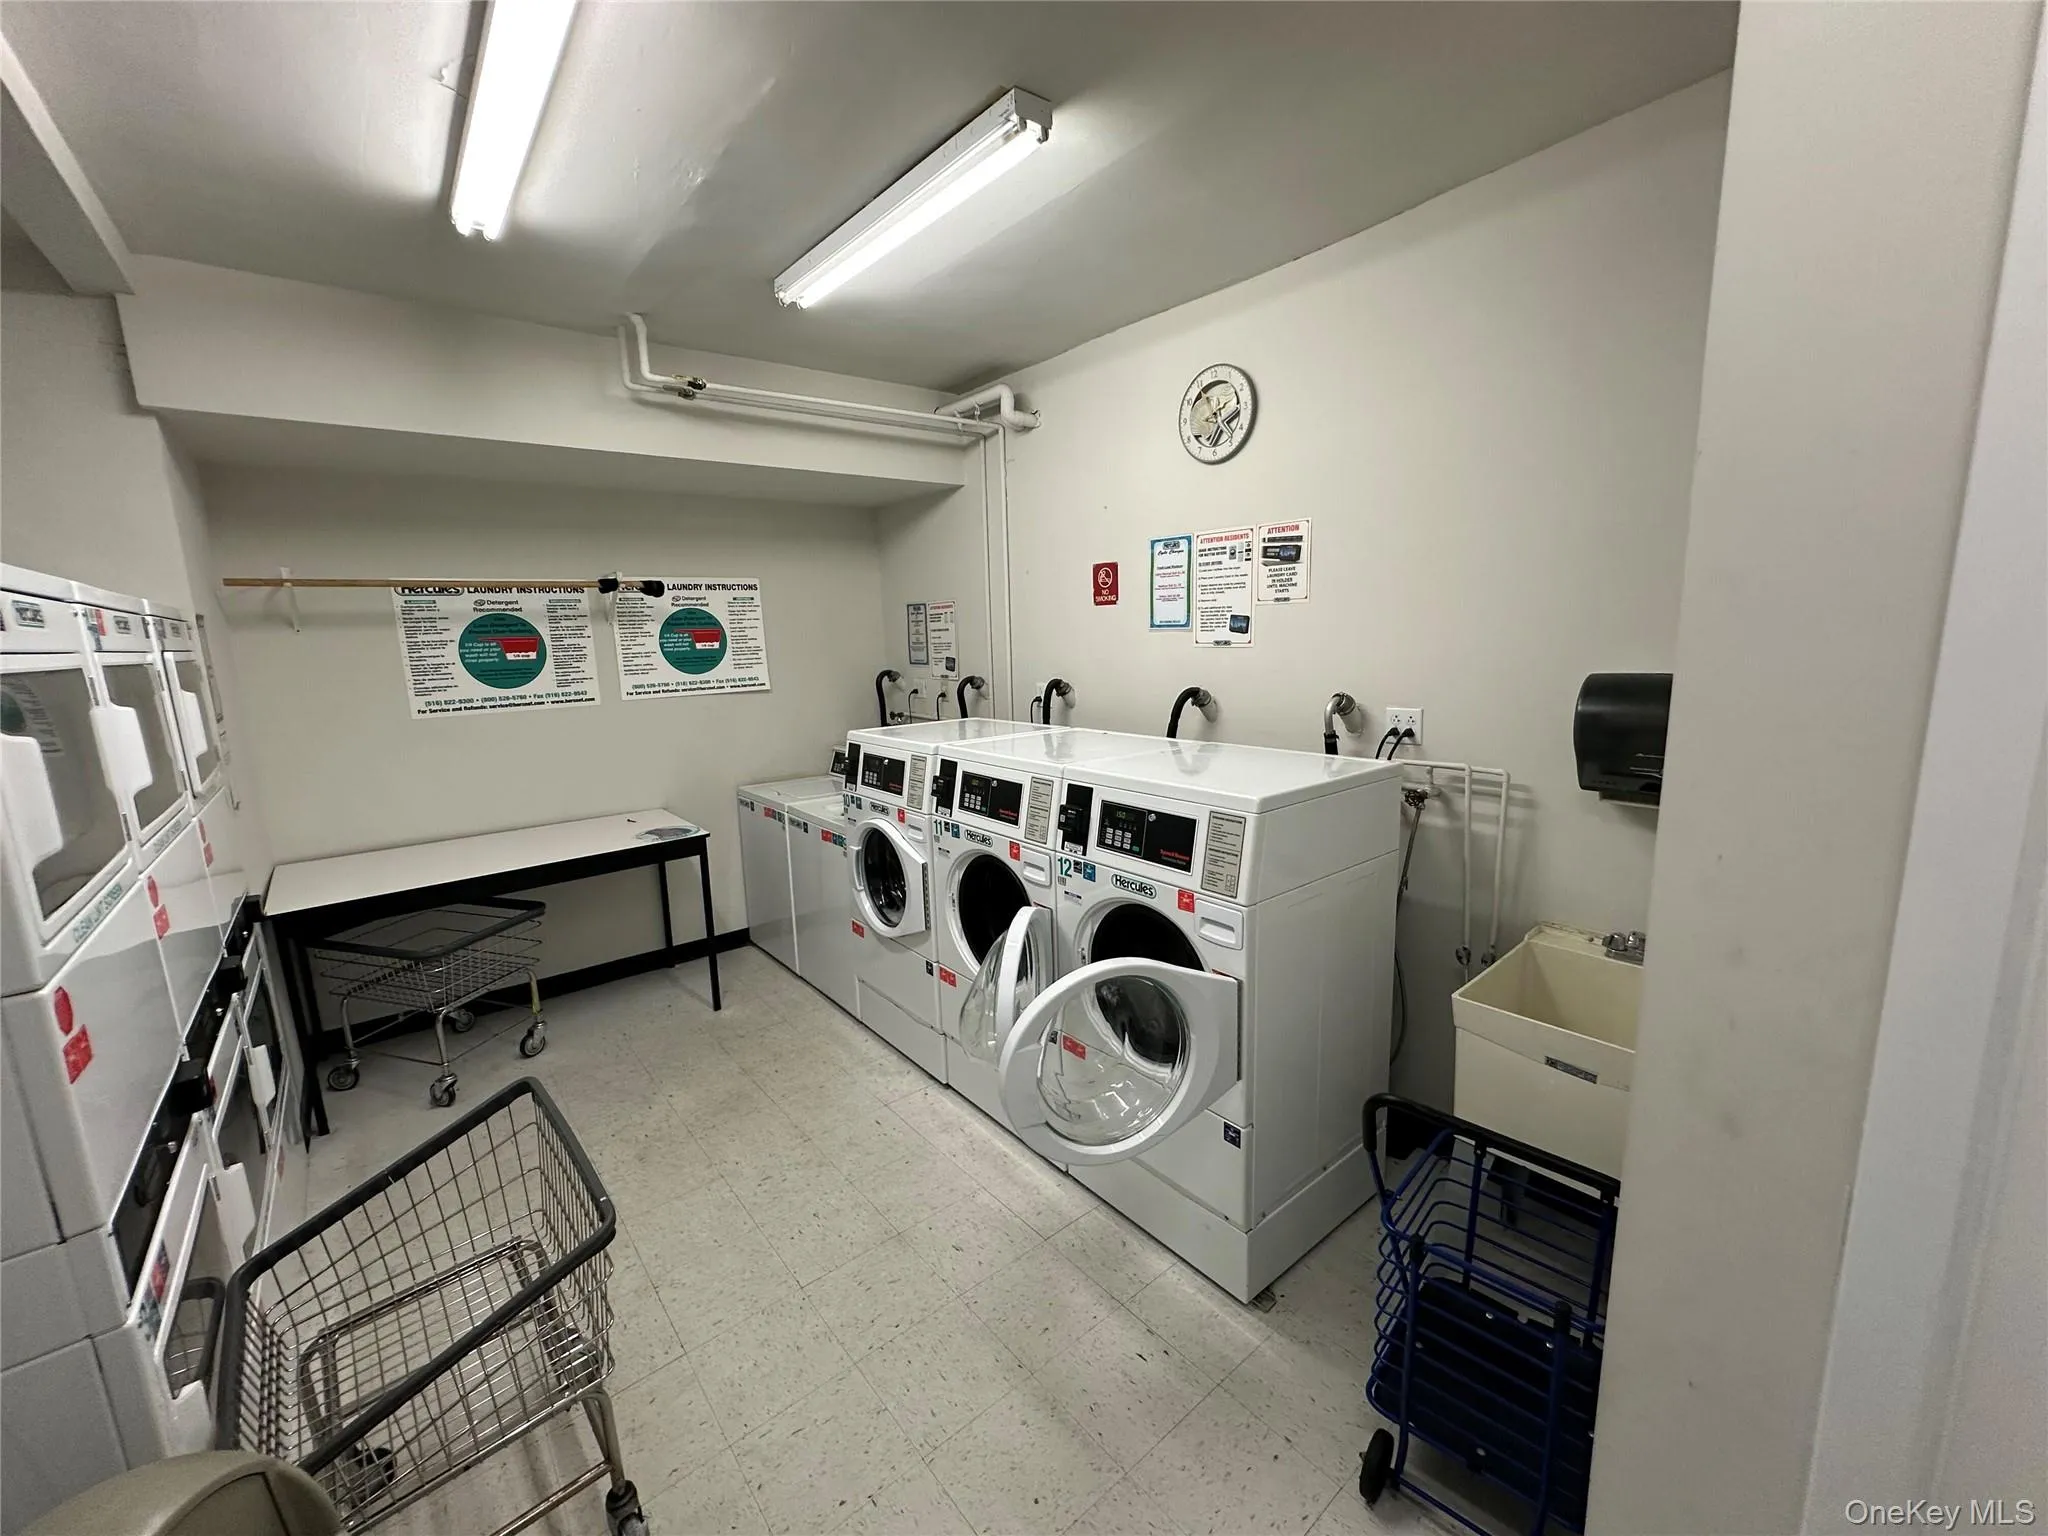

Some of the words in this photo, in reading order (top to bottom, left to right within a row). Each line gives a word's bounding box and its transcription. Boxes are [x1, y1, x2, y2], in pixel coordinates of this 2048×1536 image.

[1211, 370, 1218, 379] 12
[1267, 524, 1300, 534] ATTENTION
[1200, 536, 1223, 544] ATTENTION
[1224, 533, 1249, 541] RESIDENTS
[467, 586, 514, 594] LAUNDRY
[517, 586, 585, 594] INSTRUCTIONS
[667, 583, 702, 591] LAUNDRY
[704, 583, 758, 591] INSTRUCTIONS
[486, 599, 519, 607] Detergent
[1095, 594, 1117, 602] SMOKING
[429, 706, 451, 714] Service
[843, 794, 850, 807] 10
[934, 819, 943, 836] 11
[966, 829, 992, 845] Hercules
[1058, 856, 1073, 878] 12
[1115, 874, 1154, 896] Hercules
